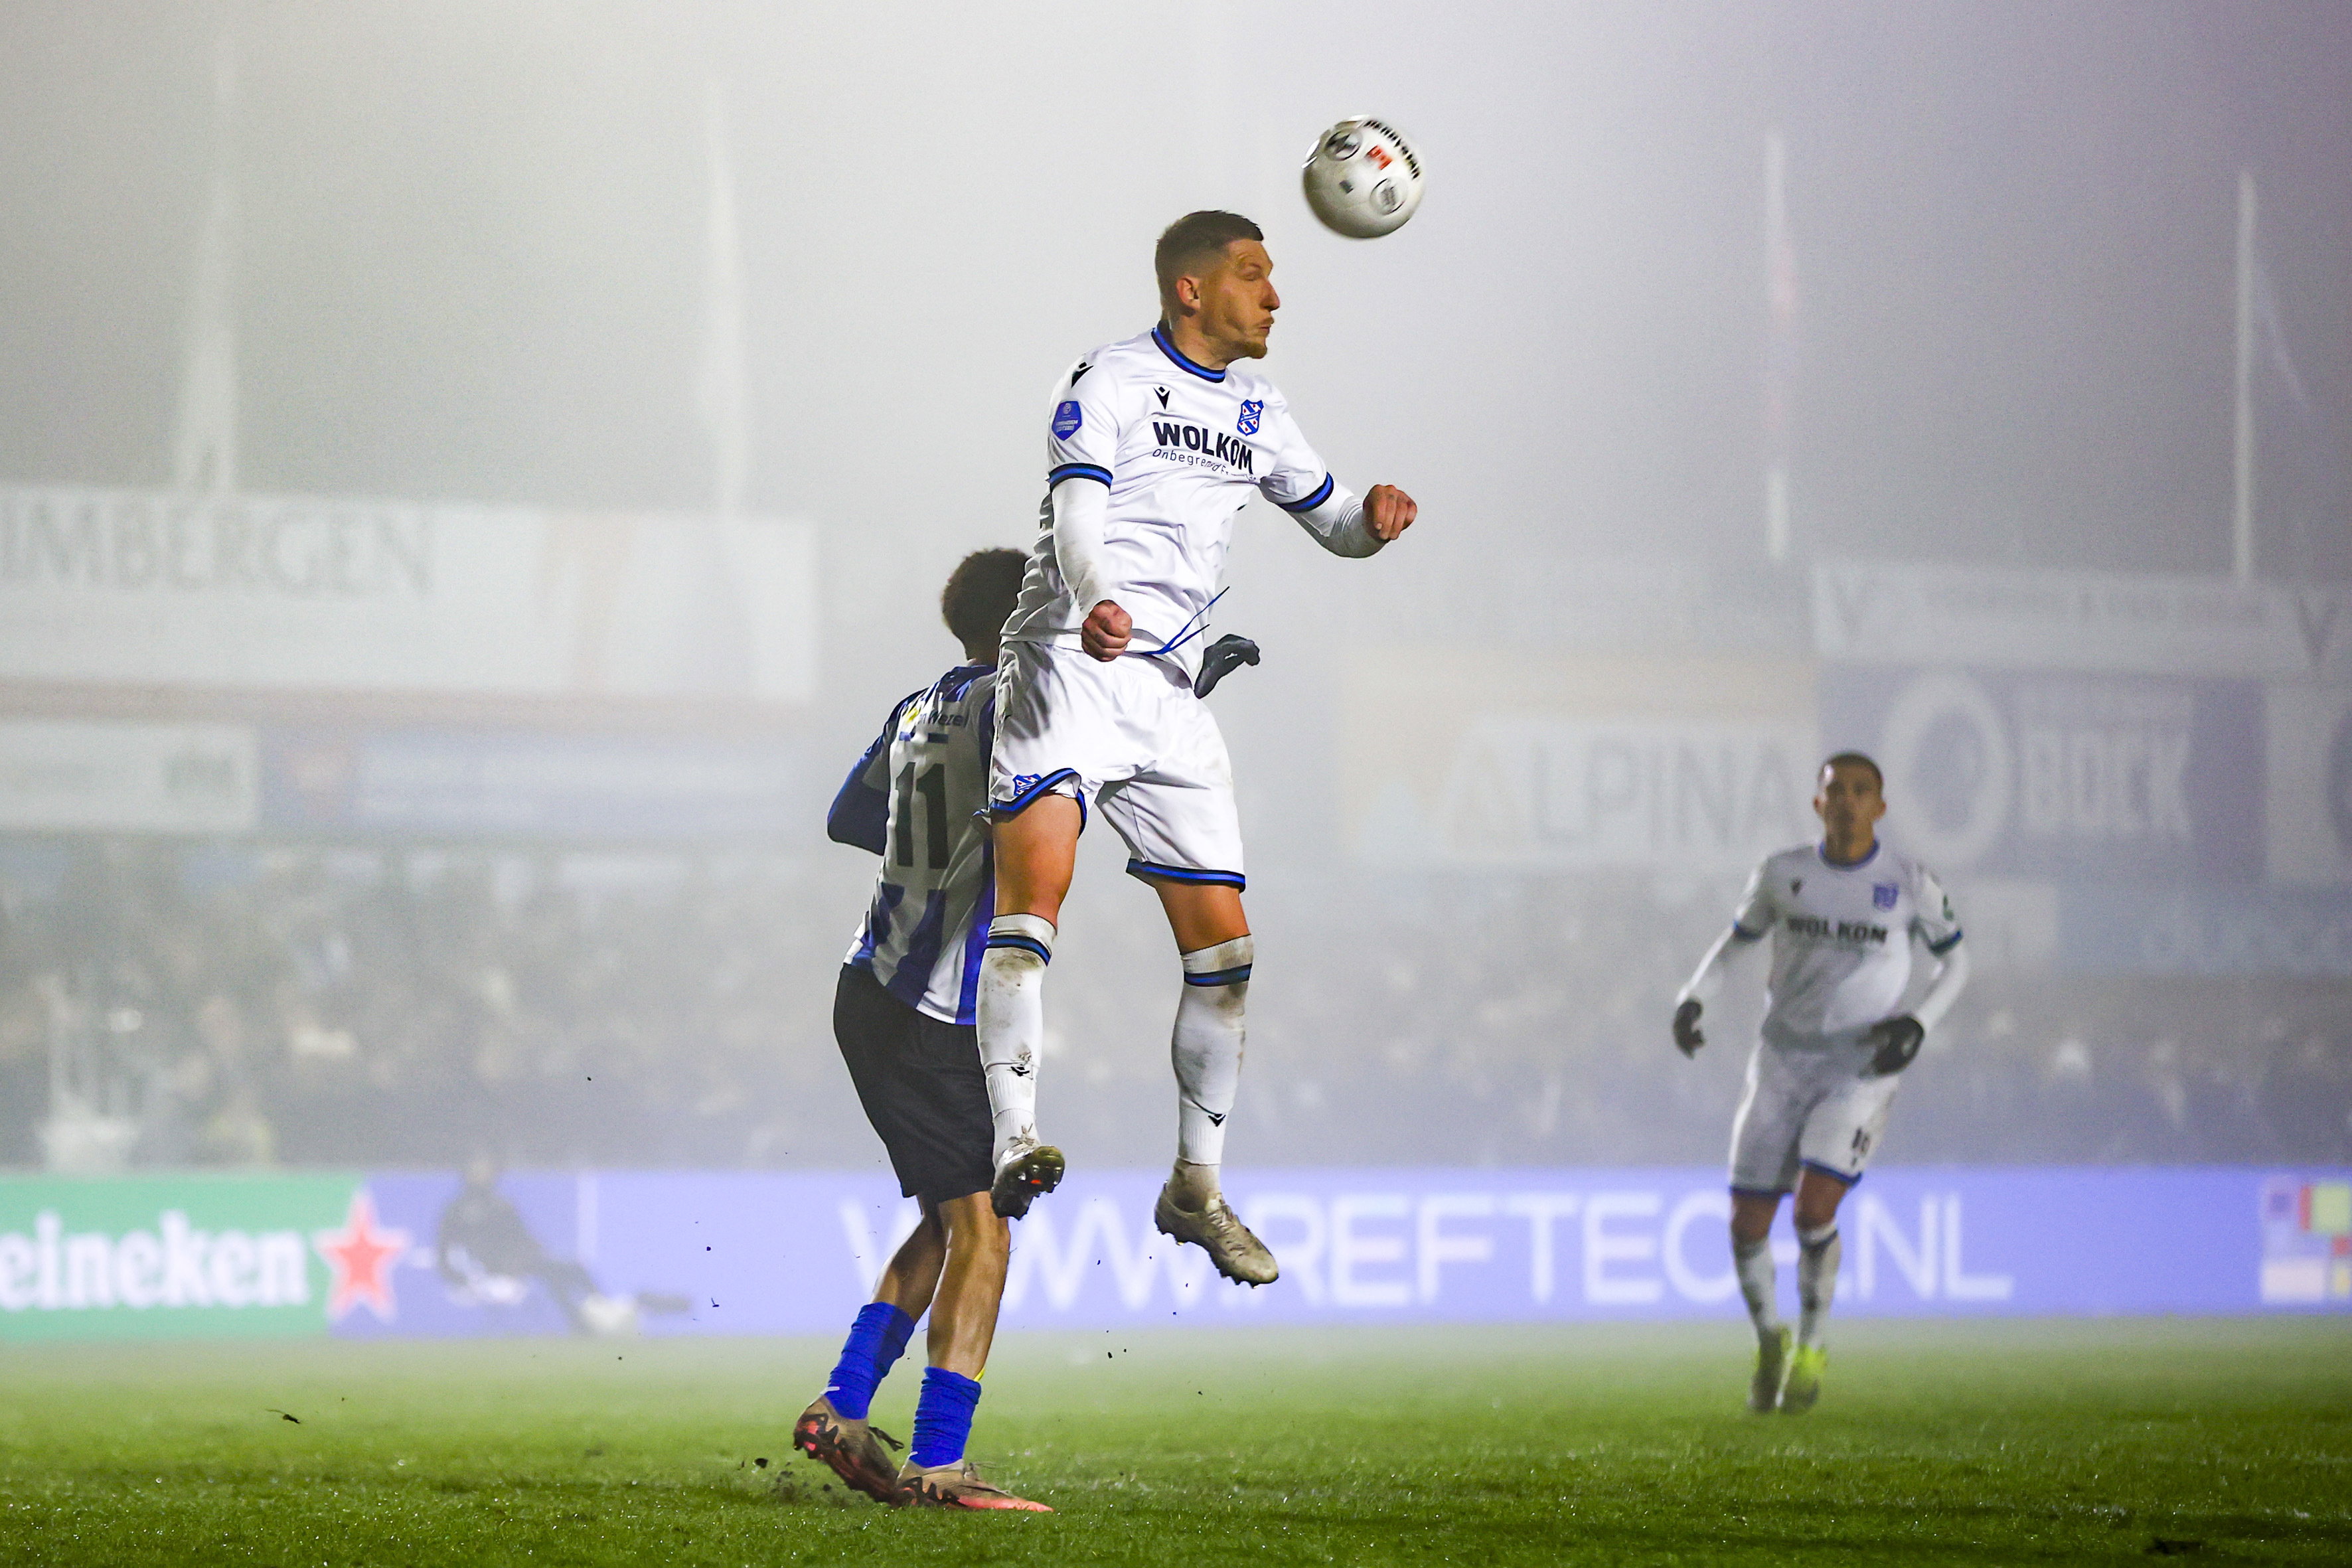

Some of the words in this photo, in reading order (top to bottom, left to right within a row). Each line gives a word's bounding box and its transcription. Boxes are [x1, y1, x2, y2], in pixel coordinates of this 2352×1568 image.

[1152, 422, 1254, 475] WOLKOM
[896, 761, 950, 870] 11
[1450, 734, 1804, 851] ALPINA
[0, 1210, 309, 1310] eineken
[838, 1190, 2013, 1311] WW.REFTEC.NL
